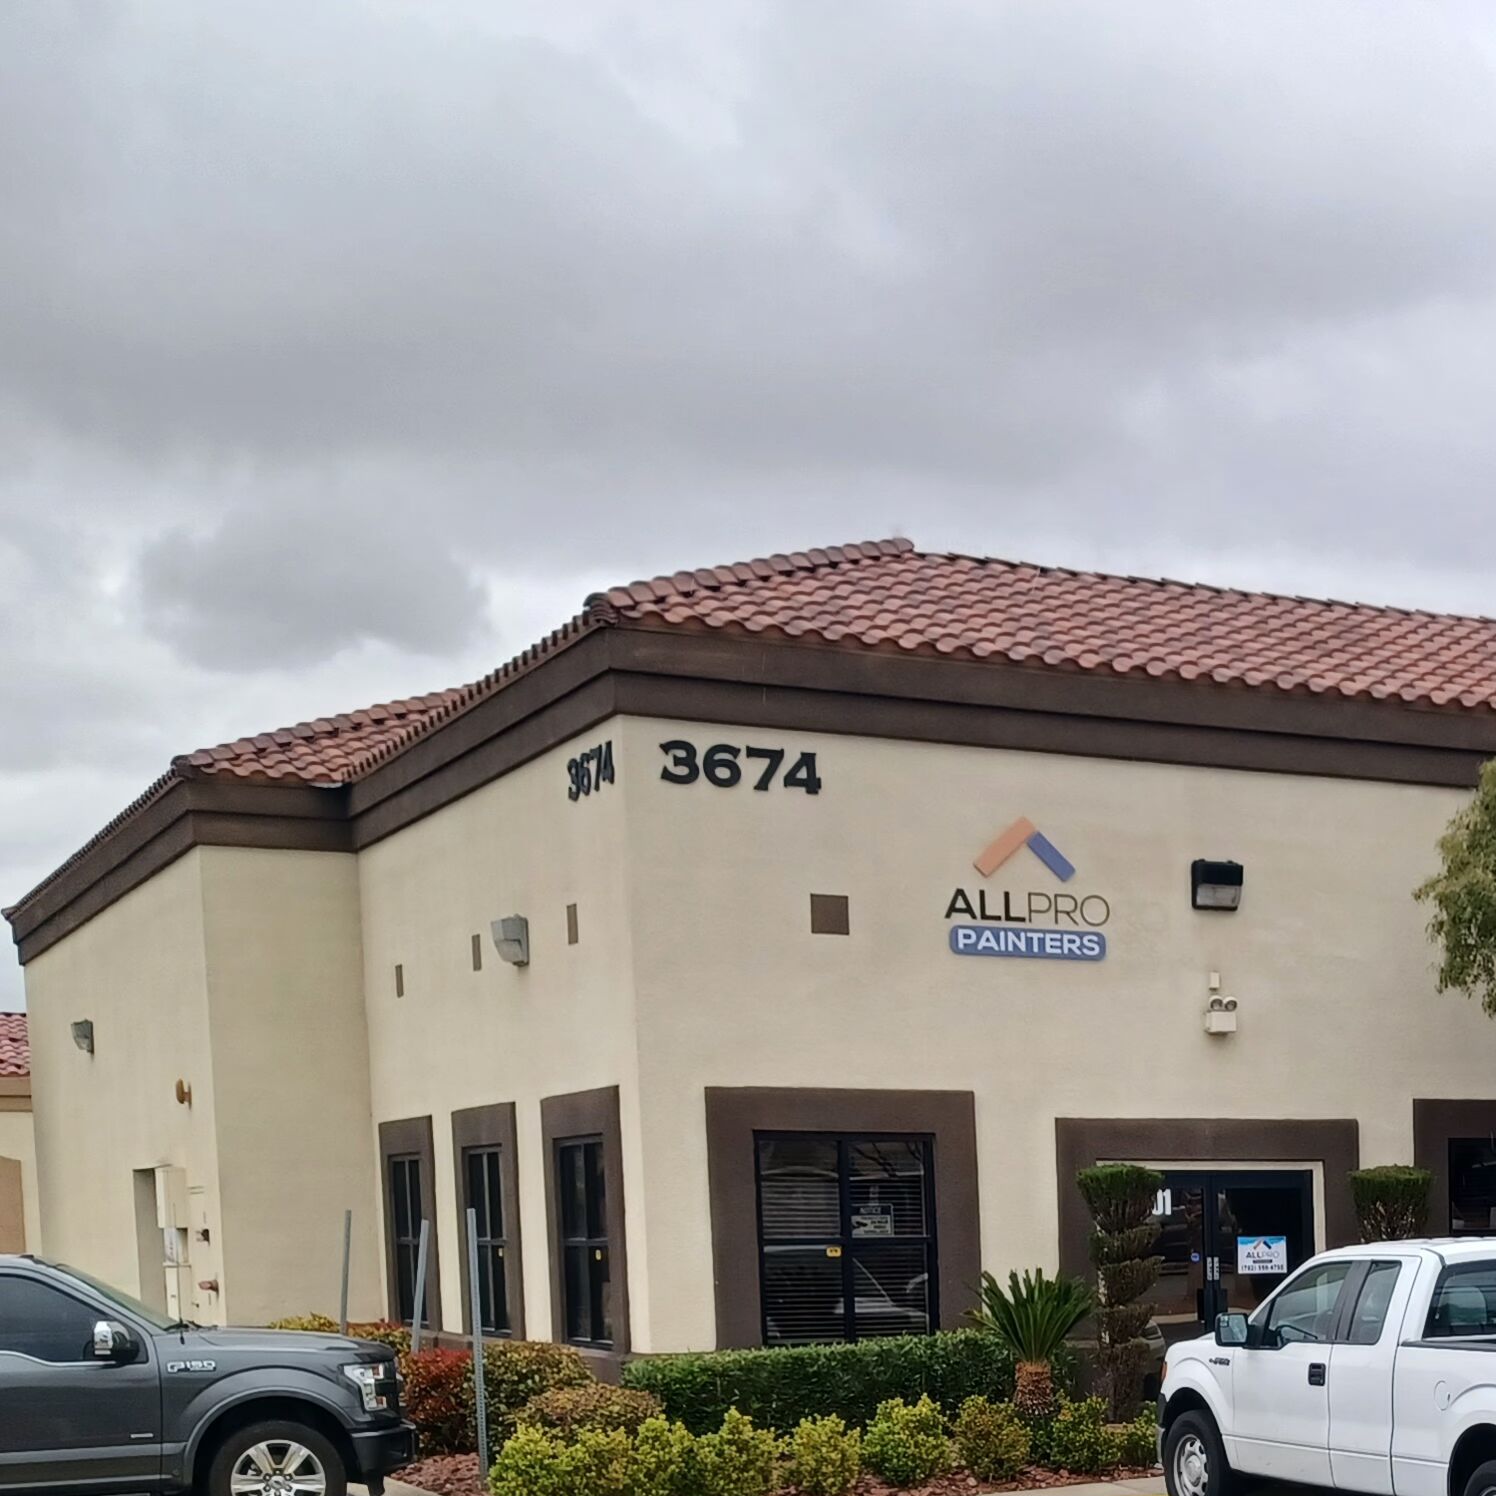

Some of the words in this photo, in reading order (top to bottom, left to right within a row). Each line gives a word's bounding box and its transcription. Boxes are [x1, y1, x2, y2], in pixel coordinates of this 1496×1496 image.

[567, 740, 615, 801] 3674
[659, 740, 822, 795] 3674
[957, 928, 1100, 956] PAINTERS
